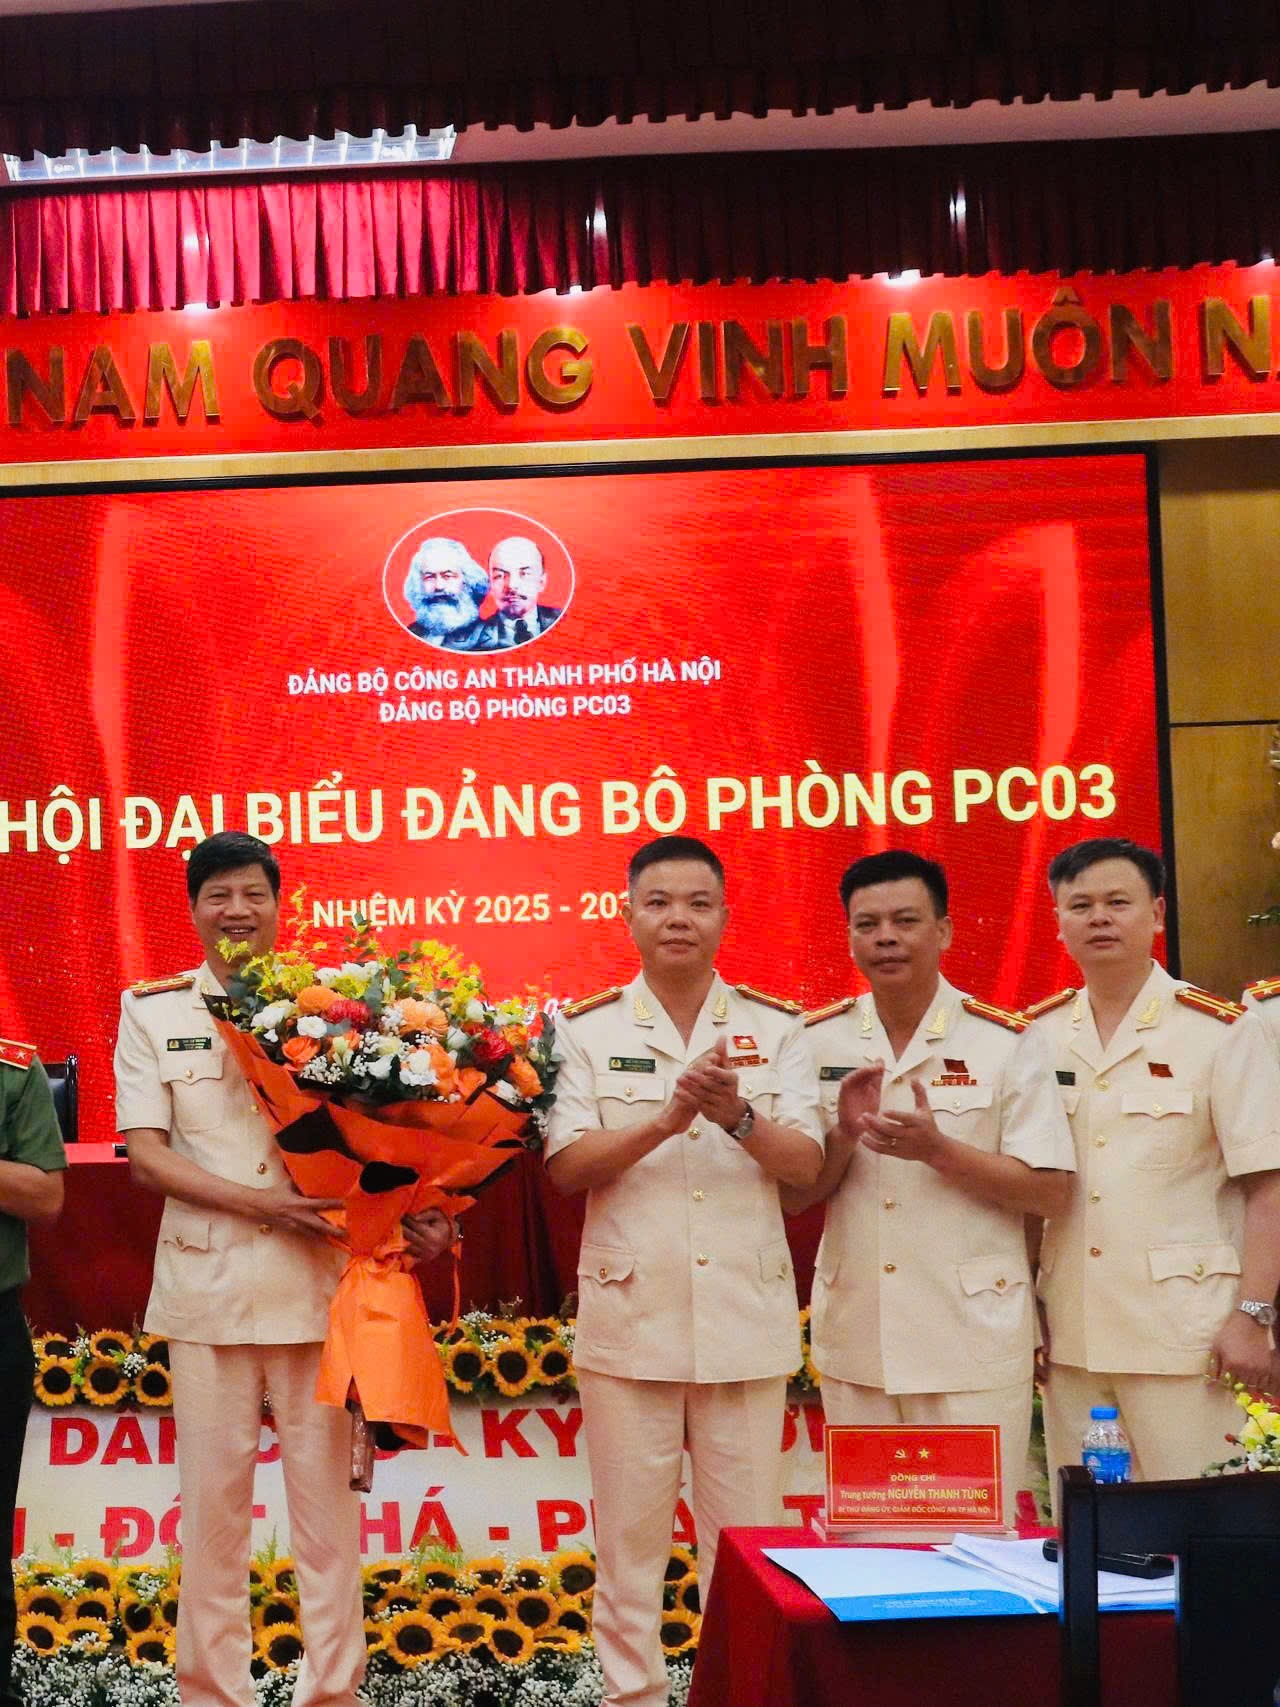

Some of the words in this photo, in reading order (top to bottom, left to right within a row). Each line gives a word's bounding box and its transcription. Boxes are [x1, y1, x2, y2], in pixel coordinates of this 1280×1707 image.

[5, 340, 220, 428] NAM
[252, 327, 594, 423] QUANG
[628, 314, 848, 404] VINH
[882, 287, 1173, 396] MUÔN
[288, 668, 352, 694] ĐẢNG
[358, 667, 388, 696] BỘ
[394, 664, 458, 690] CÔNG
[465, 667, 496, 688] AN
[502, 661, 583, 687] THÀNH
[589, 657, 637, 684] PHỐ
[643, 658, 676, 682] HÀ
[681, 656, 720, 684] NỘI
[379, 694, 443, 722] ĐẢNG
[450, 695, 480, 724] BỘ
[487, 694, 567, 719] PHÒNG
[573, 695, 631, 715] PC03
[120, 794, 223, 860] ĐẠI
[247, 771, 384, 844] BIỂU
[401, 768, 581, 840] ĐẢNG
[707, 760, 933, 831] PHÒNG
[953, 764, 1116, 823] PC03
[312, 892, 416, 932] NHIỆM
[424, 890, 467, 924] KỲ
[475, 894, 552, 924] 2025
[888, 1485, 926, 1500] NGUYỄN
[928, 1488, 960, 1500] THANH
[961, 1487, 988, 1500] TÙNG
